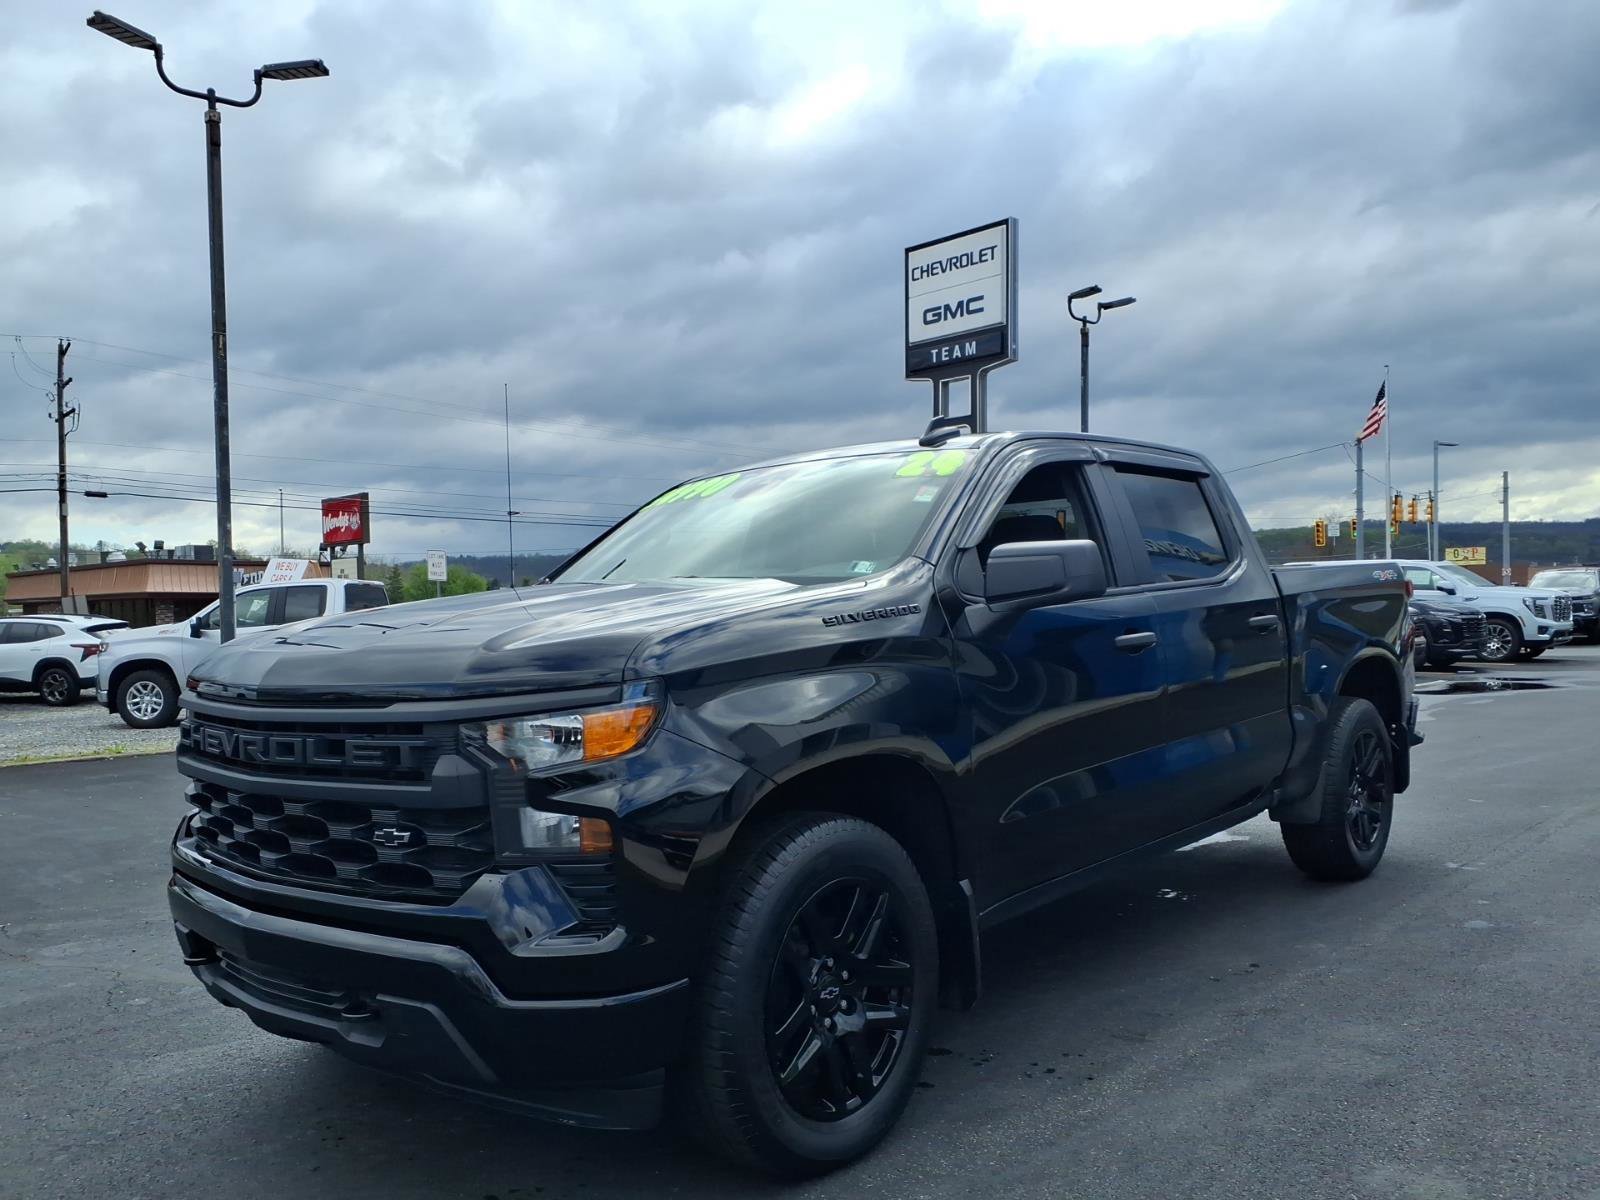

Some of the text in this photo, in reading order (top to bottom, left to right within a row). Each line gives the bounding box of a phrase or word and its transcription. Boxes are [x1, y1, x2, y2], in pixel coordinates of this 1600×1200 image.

[911, 245, 998, 282] CHEVROLET
[923, 295, 985, 326] GMC
[930, 340, 977, 363] TEAM
[822, 604, 922, 628] SILVERADO
[180, 719, 427, 767] CHEVROLET
